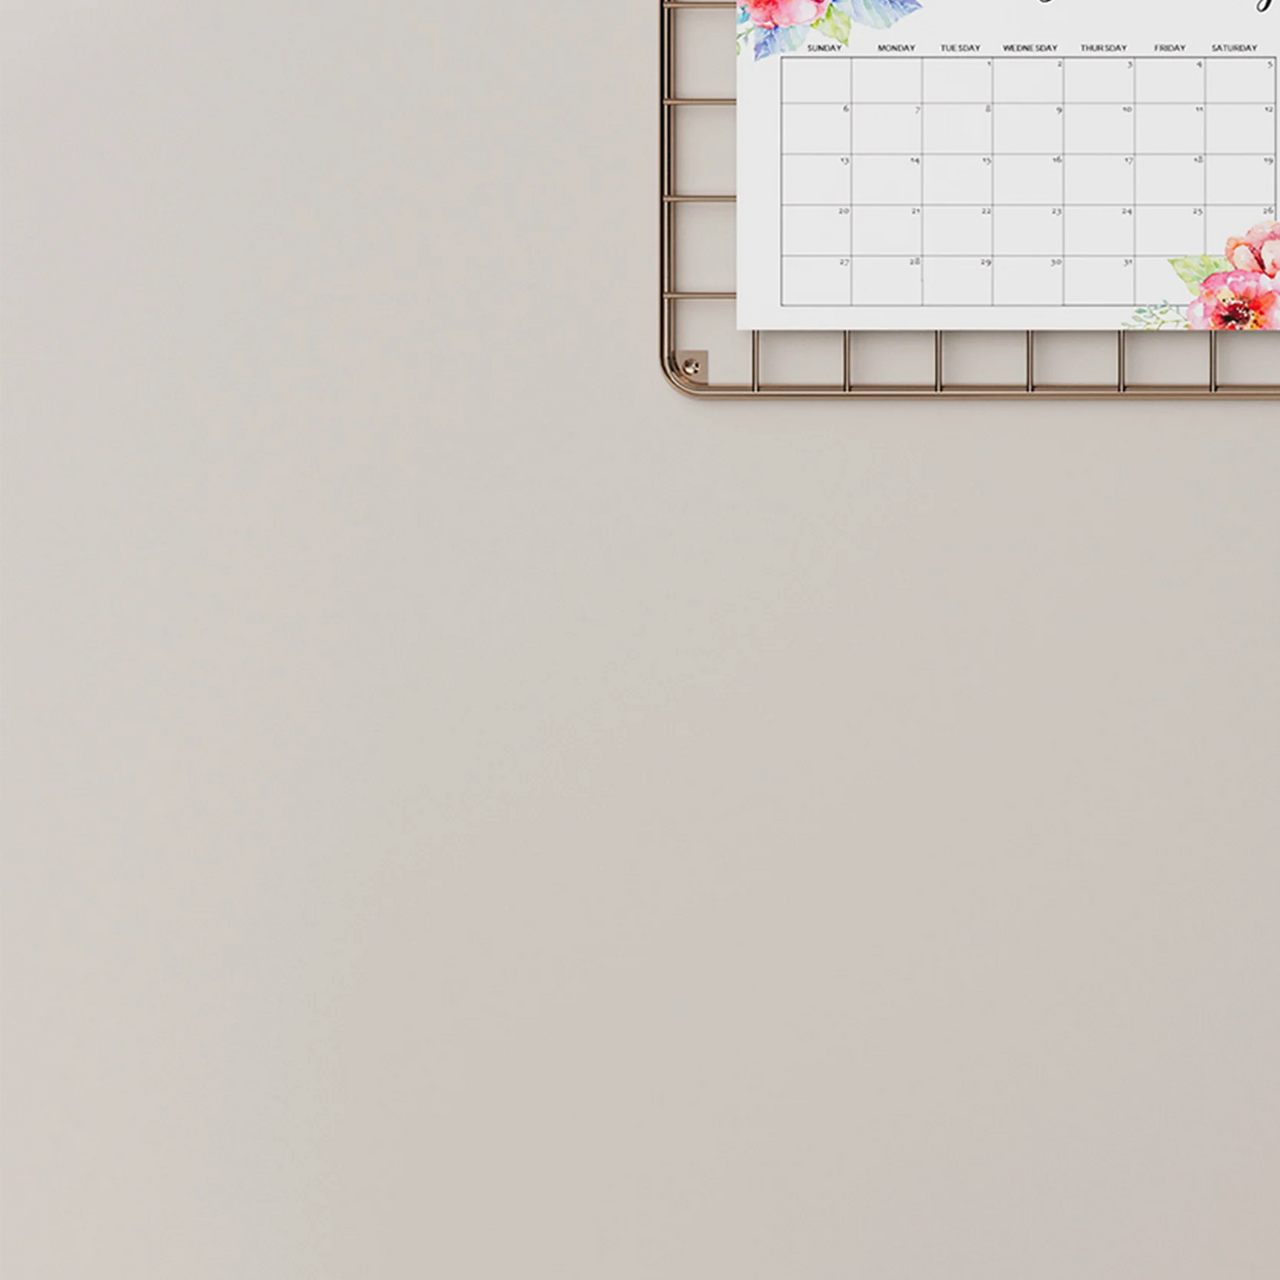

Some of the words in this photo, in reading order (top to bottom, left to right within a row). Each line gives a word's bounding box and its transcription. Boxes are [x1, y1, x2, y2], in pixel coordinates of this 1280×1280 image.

[807, 43, 843, 53] SUNDAY
[877, 43, 916, 53] MONDAY
[940, 43, 981, 53] TUESDAY
[1002, 43, 1059, 53] WEDNESDAY
[1080, 43, 1128, 53] THURSDAY
[1153, 43, 1187, 53] FRIDAY
[1211, 43, 1258, 53] SATURDAY
